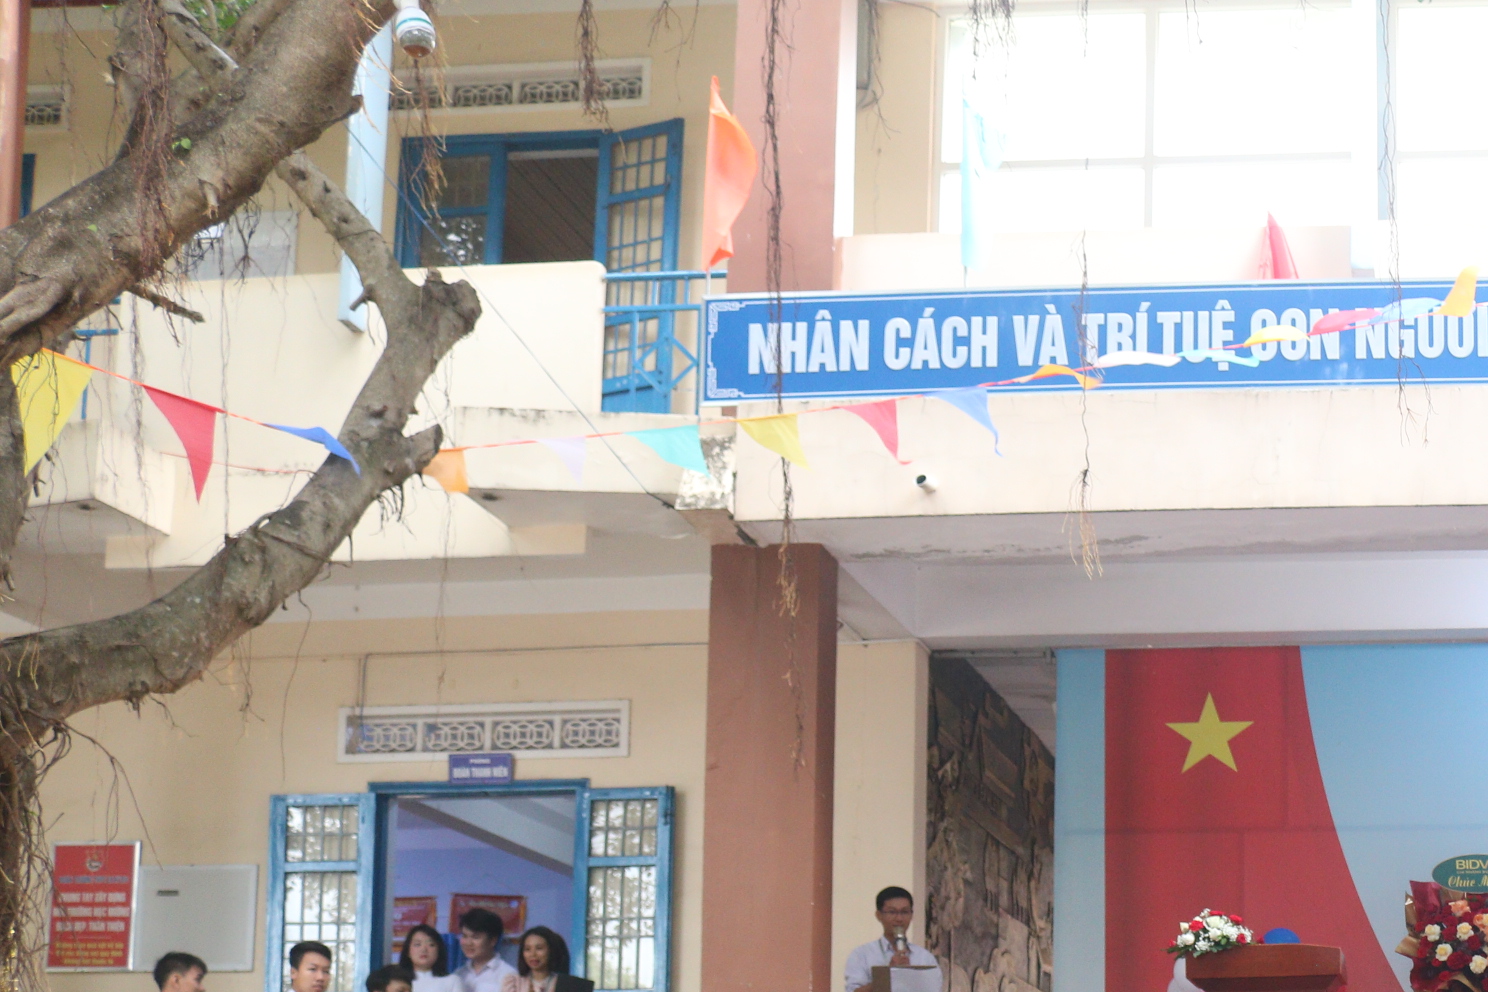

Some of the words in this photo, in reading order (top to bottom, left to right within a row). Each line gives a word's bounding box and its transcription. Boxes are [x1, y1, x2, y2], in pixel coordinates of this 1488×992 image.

[748, 309, 870, 374] NHÂN
[884, 307, 998, 370] CÁCH
[1012, 304, 1069, 366] VÀ
[1081, 302, 1151, 364] TRÍ
[1157, 299, 1236, 371] TUỆ
